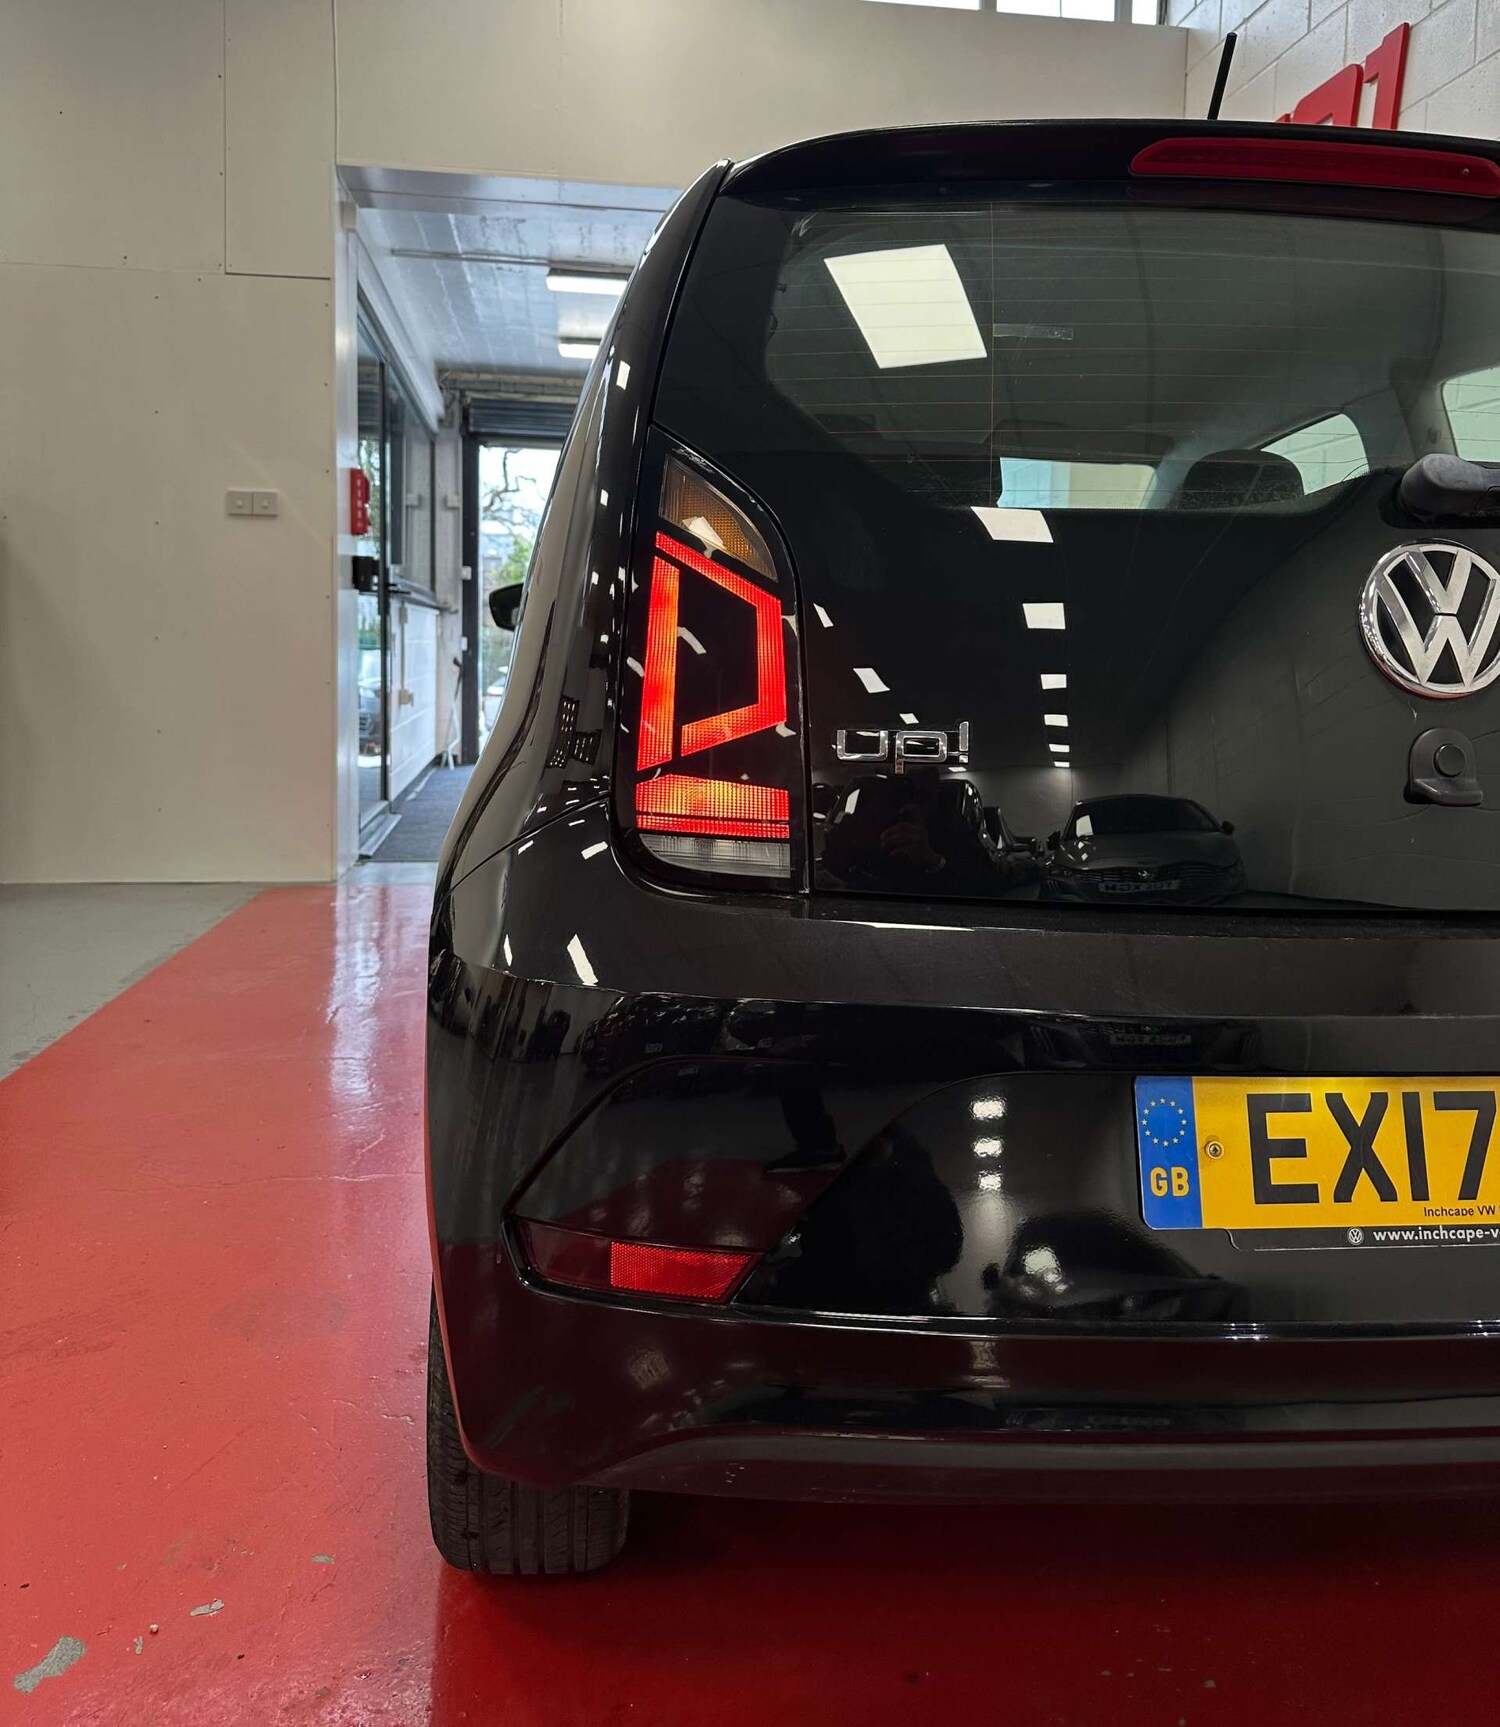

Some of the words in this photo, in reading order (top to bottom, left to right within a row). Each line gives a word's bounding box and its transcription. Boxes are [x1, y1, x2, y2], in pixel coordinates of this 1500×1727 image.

[837, 719, 969, 775] up!
[1246, 1090, 1497, 1205] EX17
[1149, 1166, 1190, 1197] GB
[1423, 1206, 1475, 1217] Inchcape
[1477, 1204, 1496, 1216] VW
[1373, 1224, 1500, 1243] www.inchcape-v
